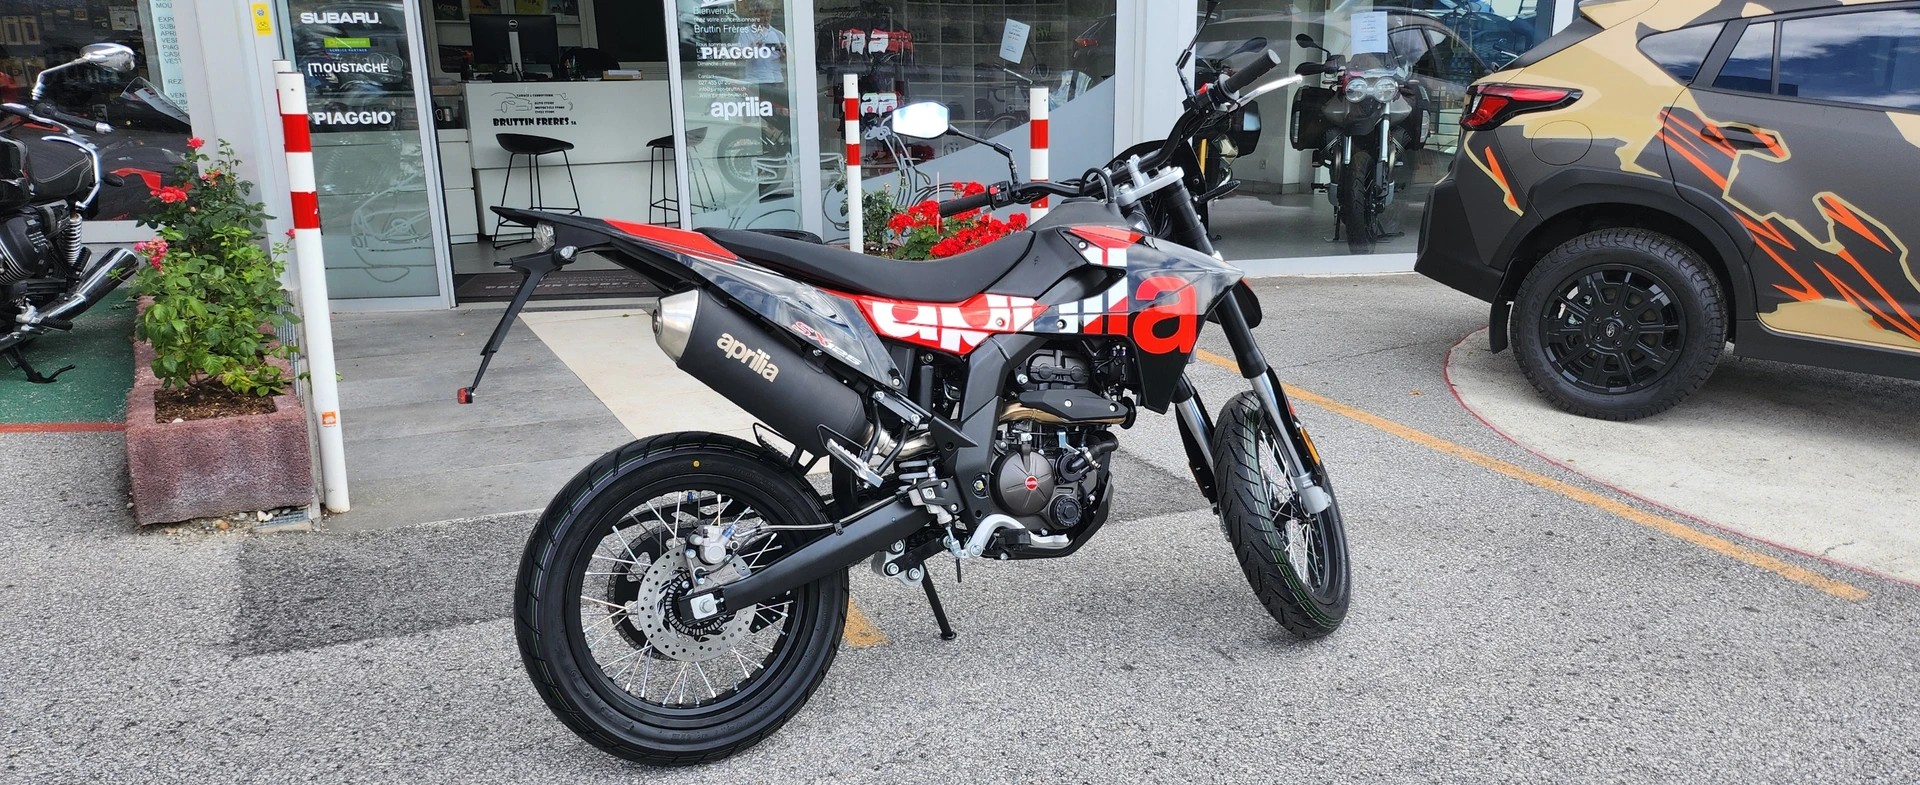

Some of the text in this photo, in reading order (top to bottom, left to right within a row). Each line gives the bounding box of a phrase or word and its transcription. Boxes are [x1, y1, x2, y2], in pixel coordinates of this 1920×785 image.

[300, 12, 379, 24] SUBARU
[693, 7, 735, 15] Bienvenue
[694, 24, 764, 33] Bruttin Frères SA
[701, 46, 771, 60] PIAGGIO
[711, 96, 773, 121] aprilia
[312, 111, 392, 125] PIAGGIO
[492, 118, 535, 127] BRUTTIN
[536, 117, 570, 126] FRERES
[871, 247, 1197, 354] aprilia
[716, 332, 780, 383] aprilia
